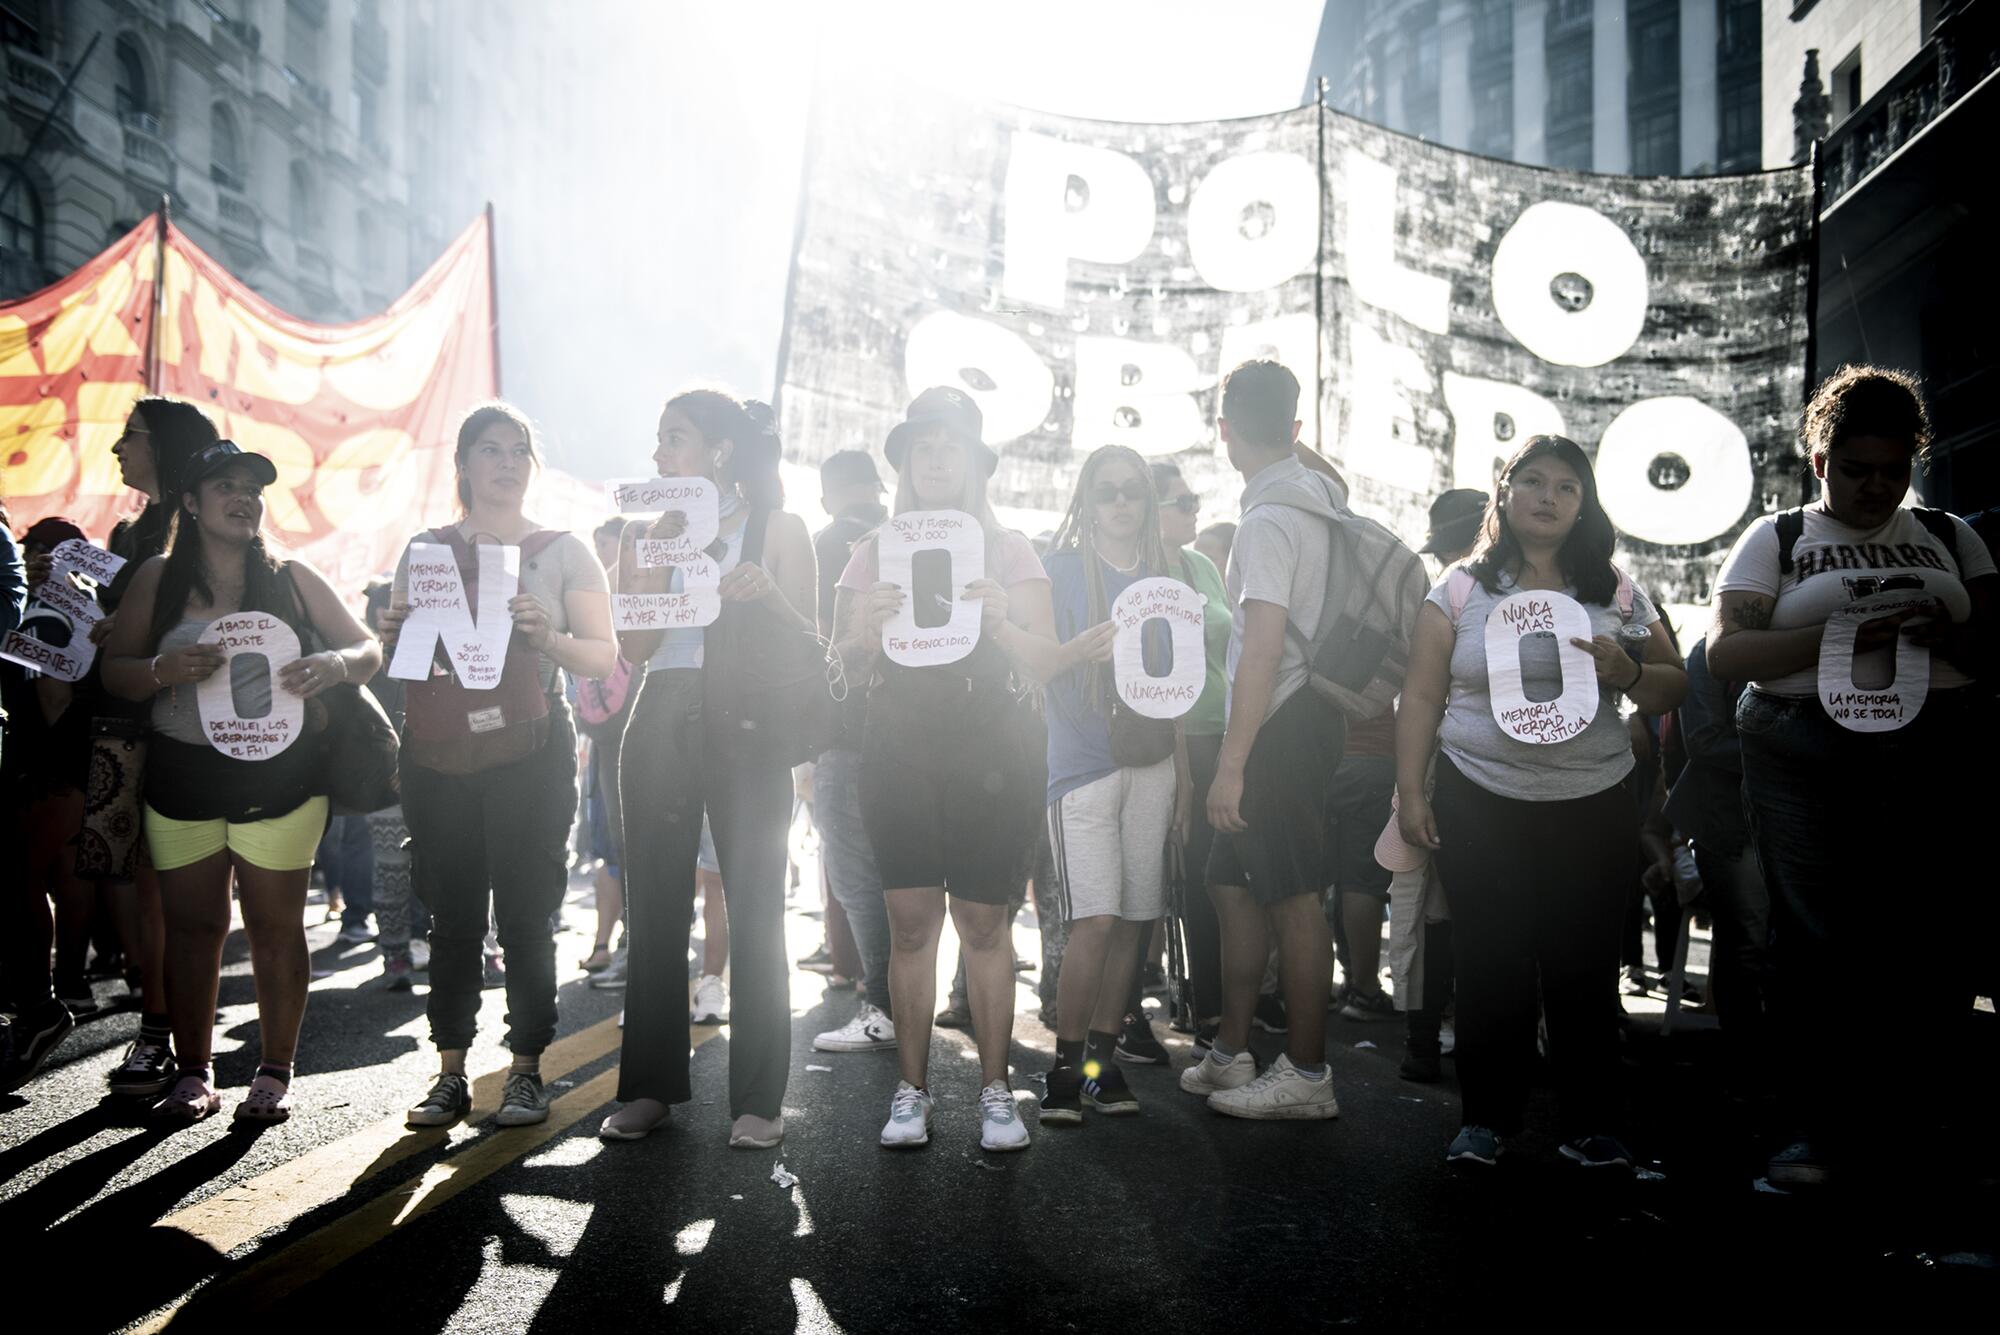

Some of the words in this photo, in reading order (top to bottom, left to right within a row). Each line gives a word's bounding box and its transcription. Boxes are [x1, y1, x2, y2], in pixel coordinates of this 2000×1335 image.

[1003, 131, 1649, 368] POLO
[613, 486, 640, 507] FUE
[641, 487, 704, 505] GENOCIDIO
[891, 518, 914, 532] SON
[917, 519, 923, 529] Y
[926, 518, 964, 530] FUERON
[902, 530, 949, 543] 30.000
[642, 539, 676, 554] ABAJO
[677, 538, 692, 549] LA
[409, 563, 458, 577] MEMORIA
[1796, 542, 1949, 584] HARVARD
[686, 567, 694, 577] Y
[696, 565, 709, 577] LA
[412, 580, 458, 594] VERDAD
[414, 597, 461, 610] JUSTICIA
[1127, 591, 1143, 606] 48
[1147, 586, 1182, 602] AÑOS
[622, 610, 656, 626] AYER
[662, 611, 671, 624] Y
[675, 607, 699, 624] HOY
[1164, 605, 1202, 625] MILITAR
[1502, 600, 1554, 625] NUNCA
[215, 620, 254, 634] ABAJO
[258, 619, 277, 630] EL
[1516, 615, 1555, 635] MAS
[217, 635, 265, 650] AJUSTE
[463, 643, 483, 653] SON
[888, 637, 910, 652] FUE
[1829, 692, 1844, 706] LA
[1846, 693, 1901, 706] MEMORIA
[1501, 702, 1559, 724] MEMORIA
[1834, 709, 1850, 720] NO
[1853, 709, 1868, 719] SE
[209, 721, 224, 731] DE
[268, 719, 289, 731] LOS
[1513, 714, 1564, 736] VERDAD
[1535, 716, 1589, 744] JUSTICIA
[282, 733, 289, 743] Y
[231, 746, 244, 757] EL
[246, 745, 269, 757] FMI
